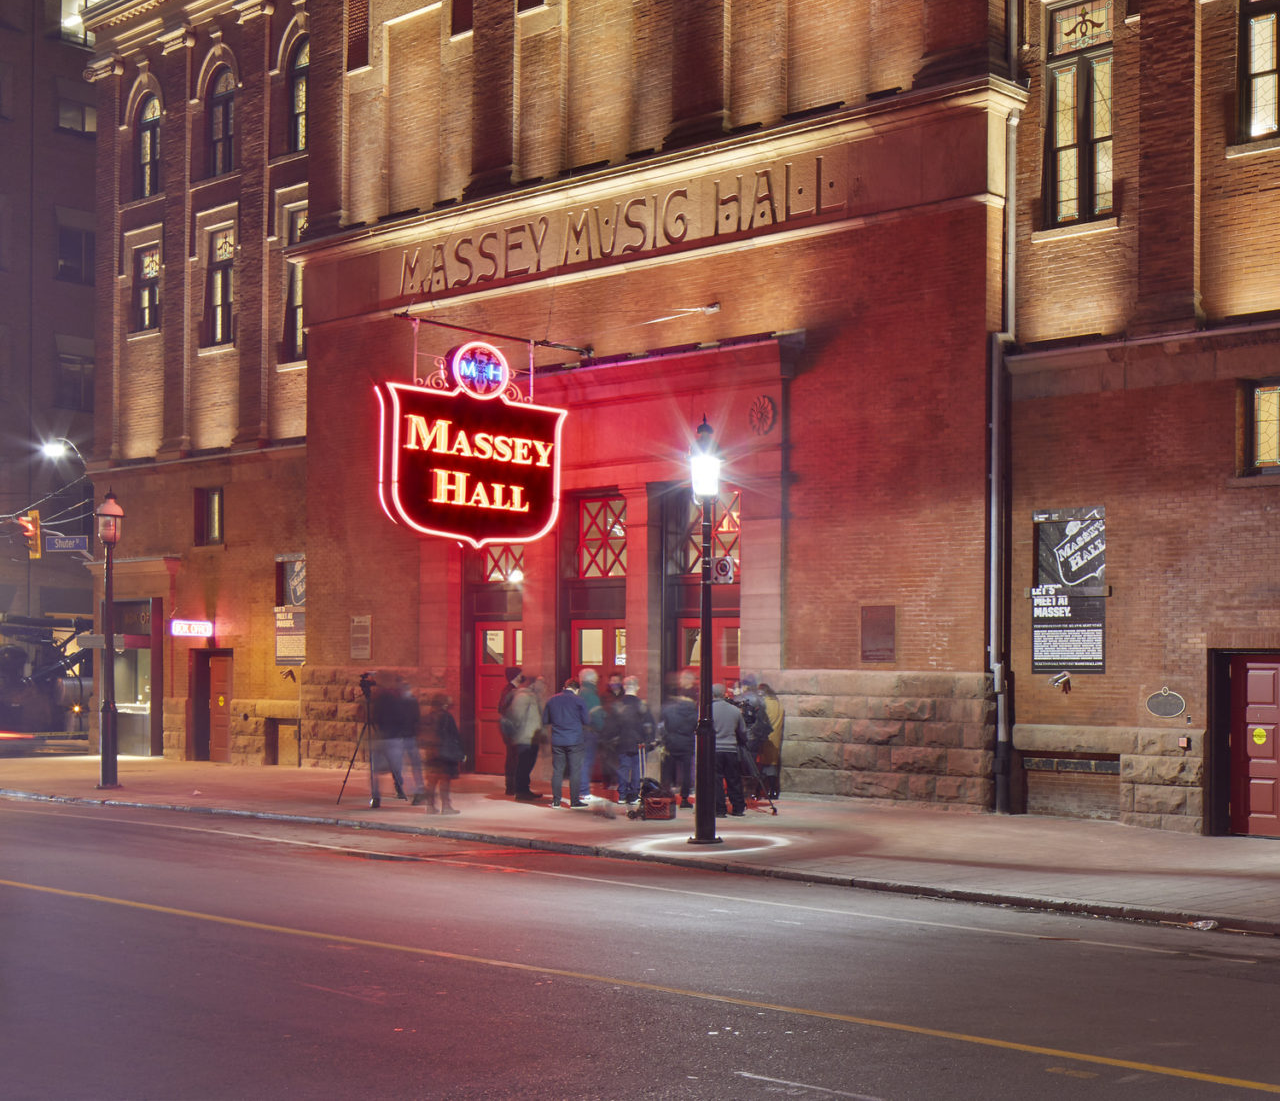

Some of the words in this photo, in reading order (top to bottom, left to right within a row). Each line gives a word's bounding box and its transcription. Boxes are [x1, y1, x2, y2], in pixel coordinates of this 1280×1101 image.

[400, 215, 548, 296] MASSEY
[713, 155, 847, 236] HALL
[460, 360, 477, 378] M
[488, 363, 503, 382] H
[403, 414, 554, 468] MASSEY
[428, 468, 530, 513] HALL
[54, 538, 75, 548] Shuter
[1068, 538, 1105, 571] HALL
[1032, 595, 1055, 606] MEET
[1033, 606, 1072, 618] MASSEY.
